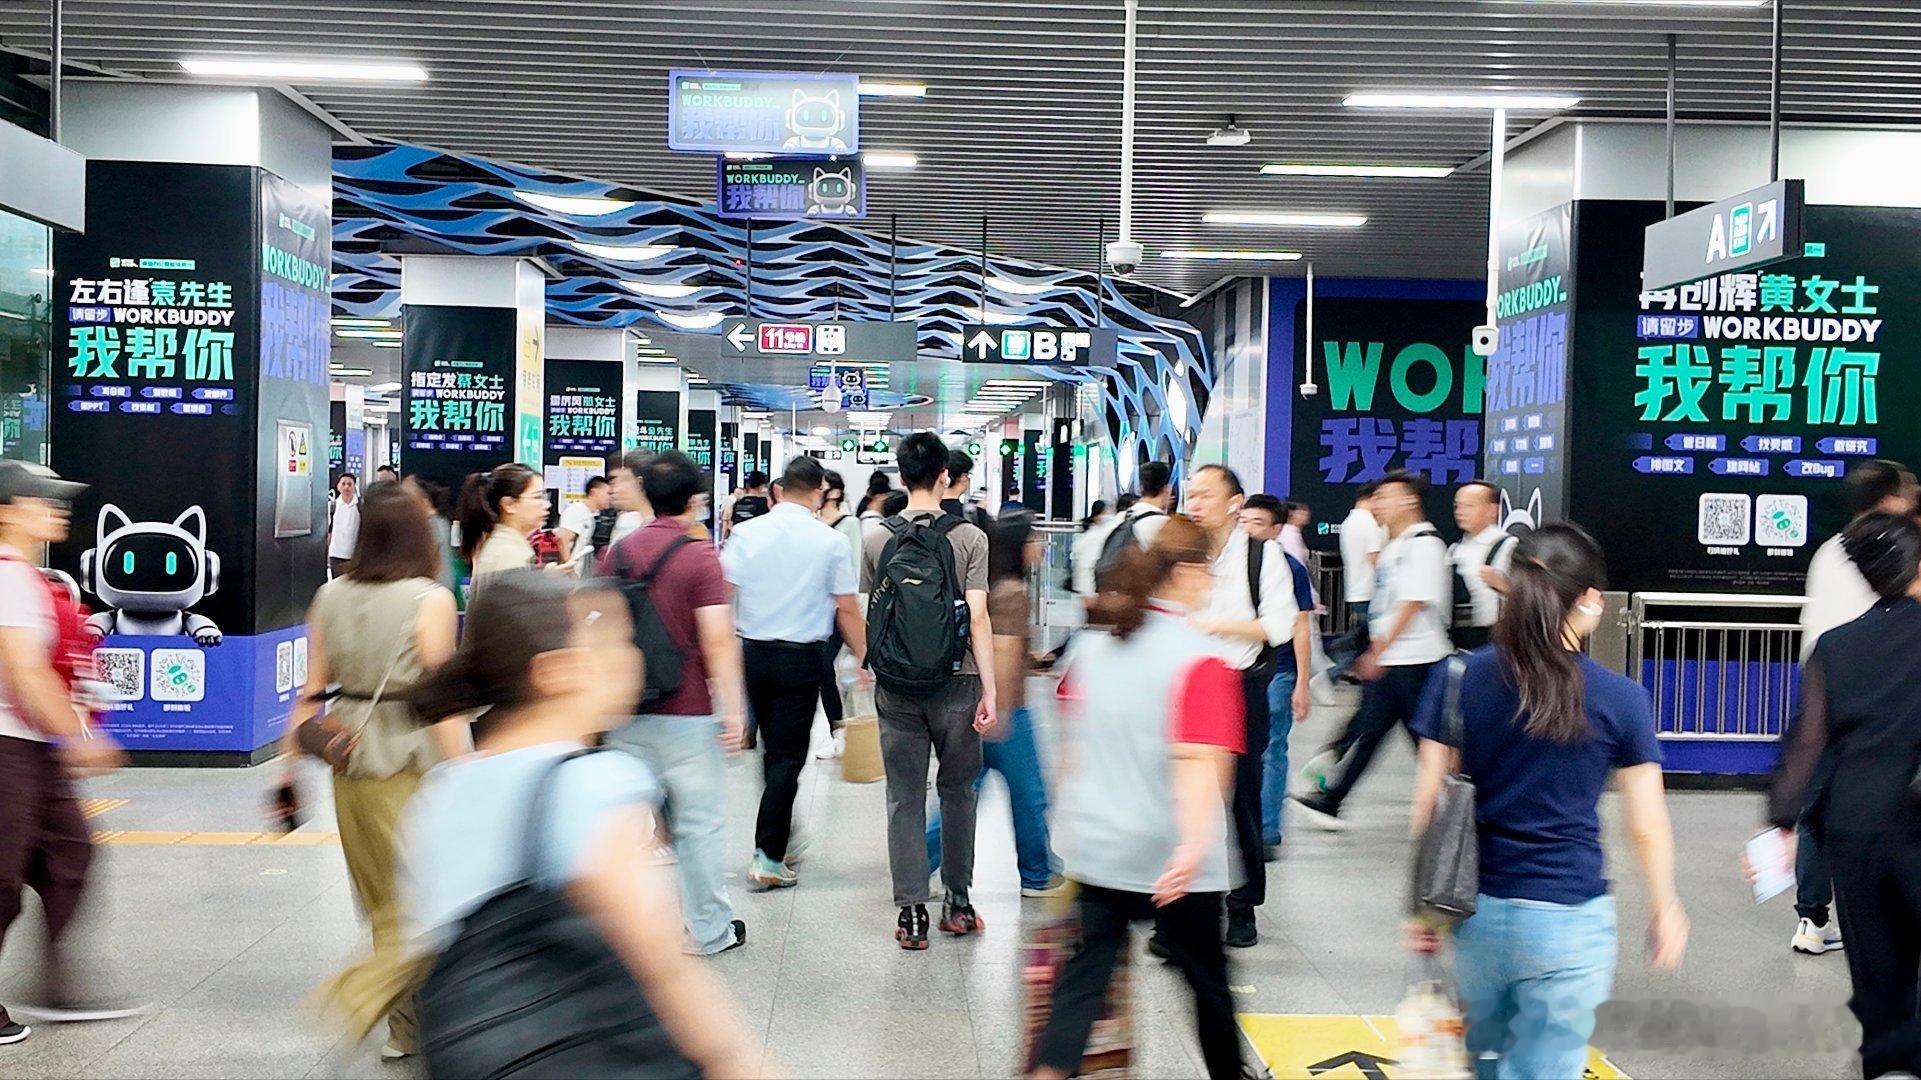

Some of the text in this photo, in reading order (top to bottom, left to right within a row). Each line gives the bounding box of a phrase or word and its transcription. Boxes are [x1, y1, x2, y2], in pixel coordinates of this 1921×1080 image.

[683, 109, 780, 140] 我帮你
[726, 184, 805, 209] 我帮你
[1706, 213, 1726, 264] A
[113, 308, 235, 326] WORKBUDDY
[1642, 316, 1882, 342] 请留步 WORKBUDDY
[68, 326, 235, 381] 我帮你
[1033, 331, 1058, 360] B
[435, 389, 505, 400] WORKBUDDY
[1634, 343, 1881, 426] 我帮你
[410, 399, 505, 431] 我帮你
[549, 415, 616, 437] 我帮你
[1801, 462, 1835, 477] 改Bug
